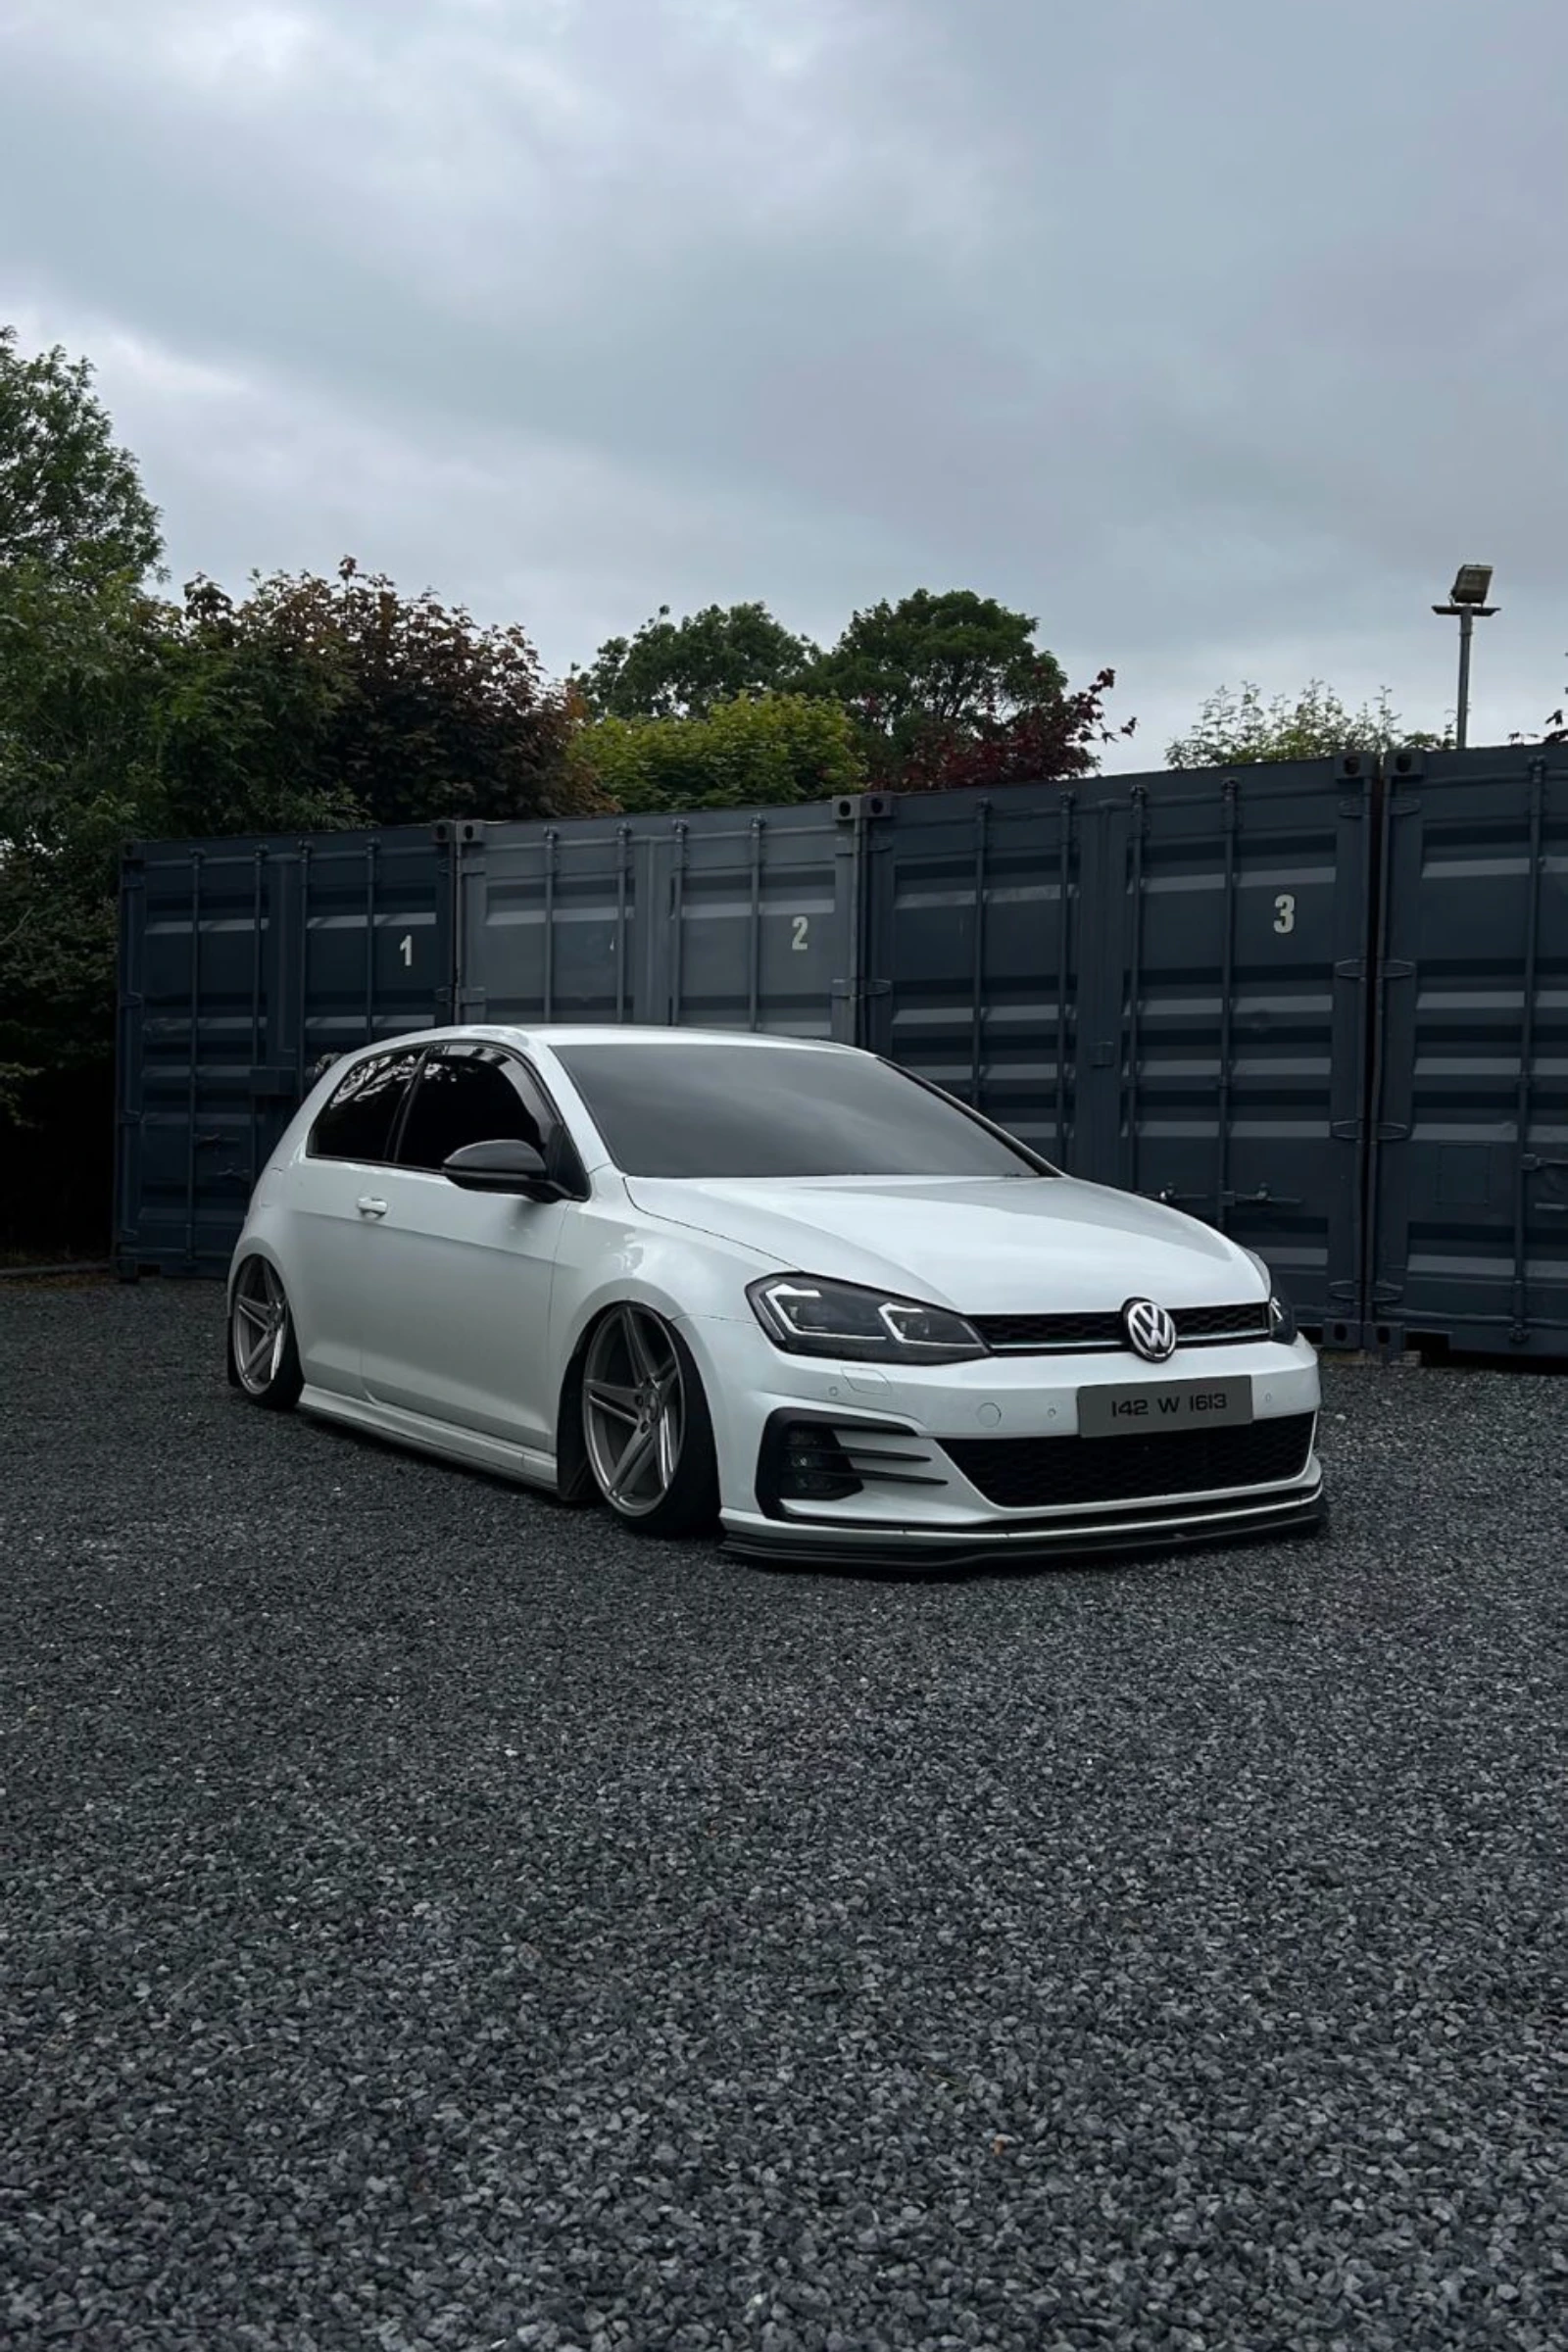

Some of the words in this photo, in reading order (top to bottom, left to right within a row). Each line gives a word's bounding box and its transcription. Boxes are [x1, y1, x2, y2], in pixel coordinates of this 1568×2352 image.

[1273, 894, 1295, 934] 3
[791, 916, 808, 951] 2
[399, 935, 412, 966] 1
[1111, 1399, 1149, 1417] 142
[1157, 1396, 1181, 1413] W
[1190, 1393, 1228, 1411] 1613
